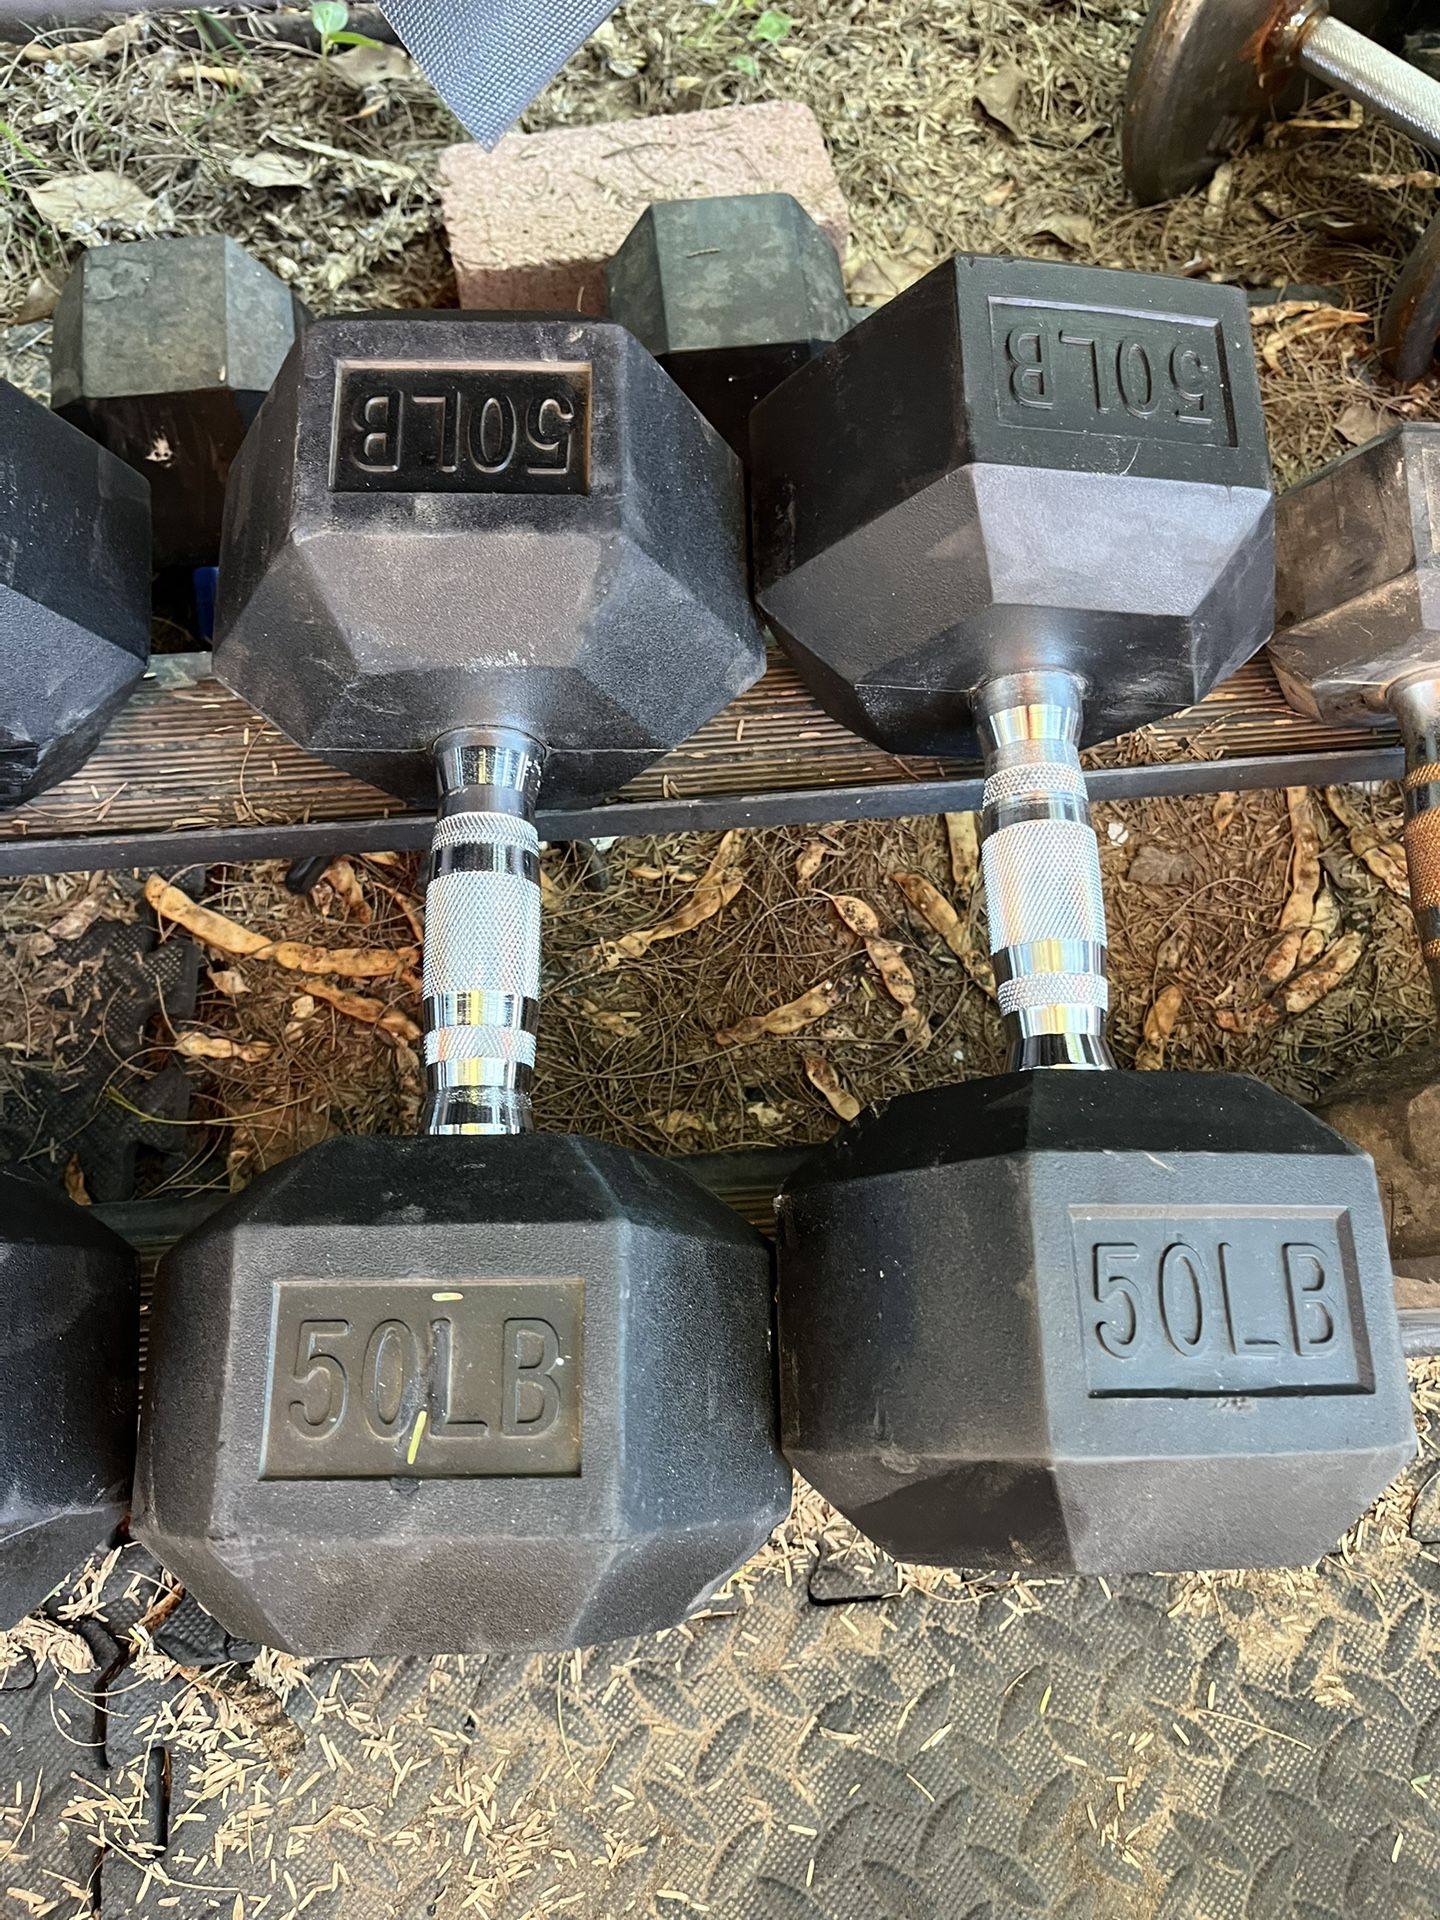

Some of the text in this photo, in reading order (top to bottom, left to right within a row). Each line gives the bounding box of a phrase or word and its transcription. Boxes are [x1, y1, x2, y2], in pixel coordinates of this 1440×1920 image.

[1004, 326, 1212, 424] 50LB
[352, 389, 575, 475] 50LB
[1092, 1241, 1337, 1359] 50LB
[288, 1317, 564, 1441] 50LB
